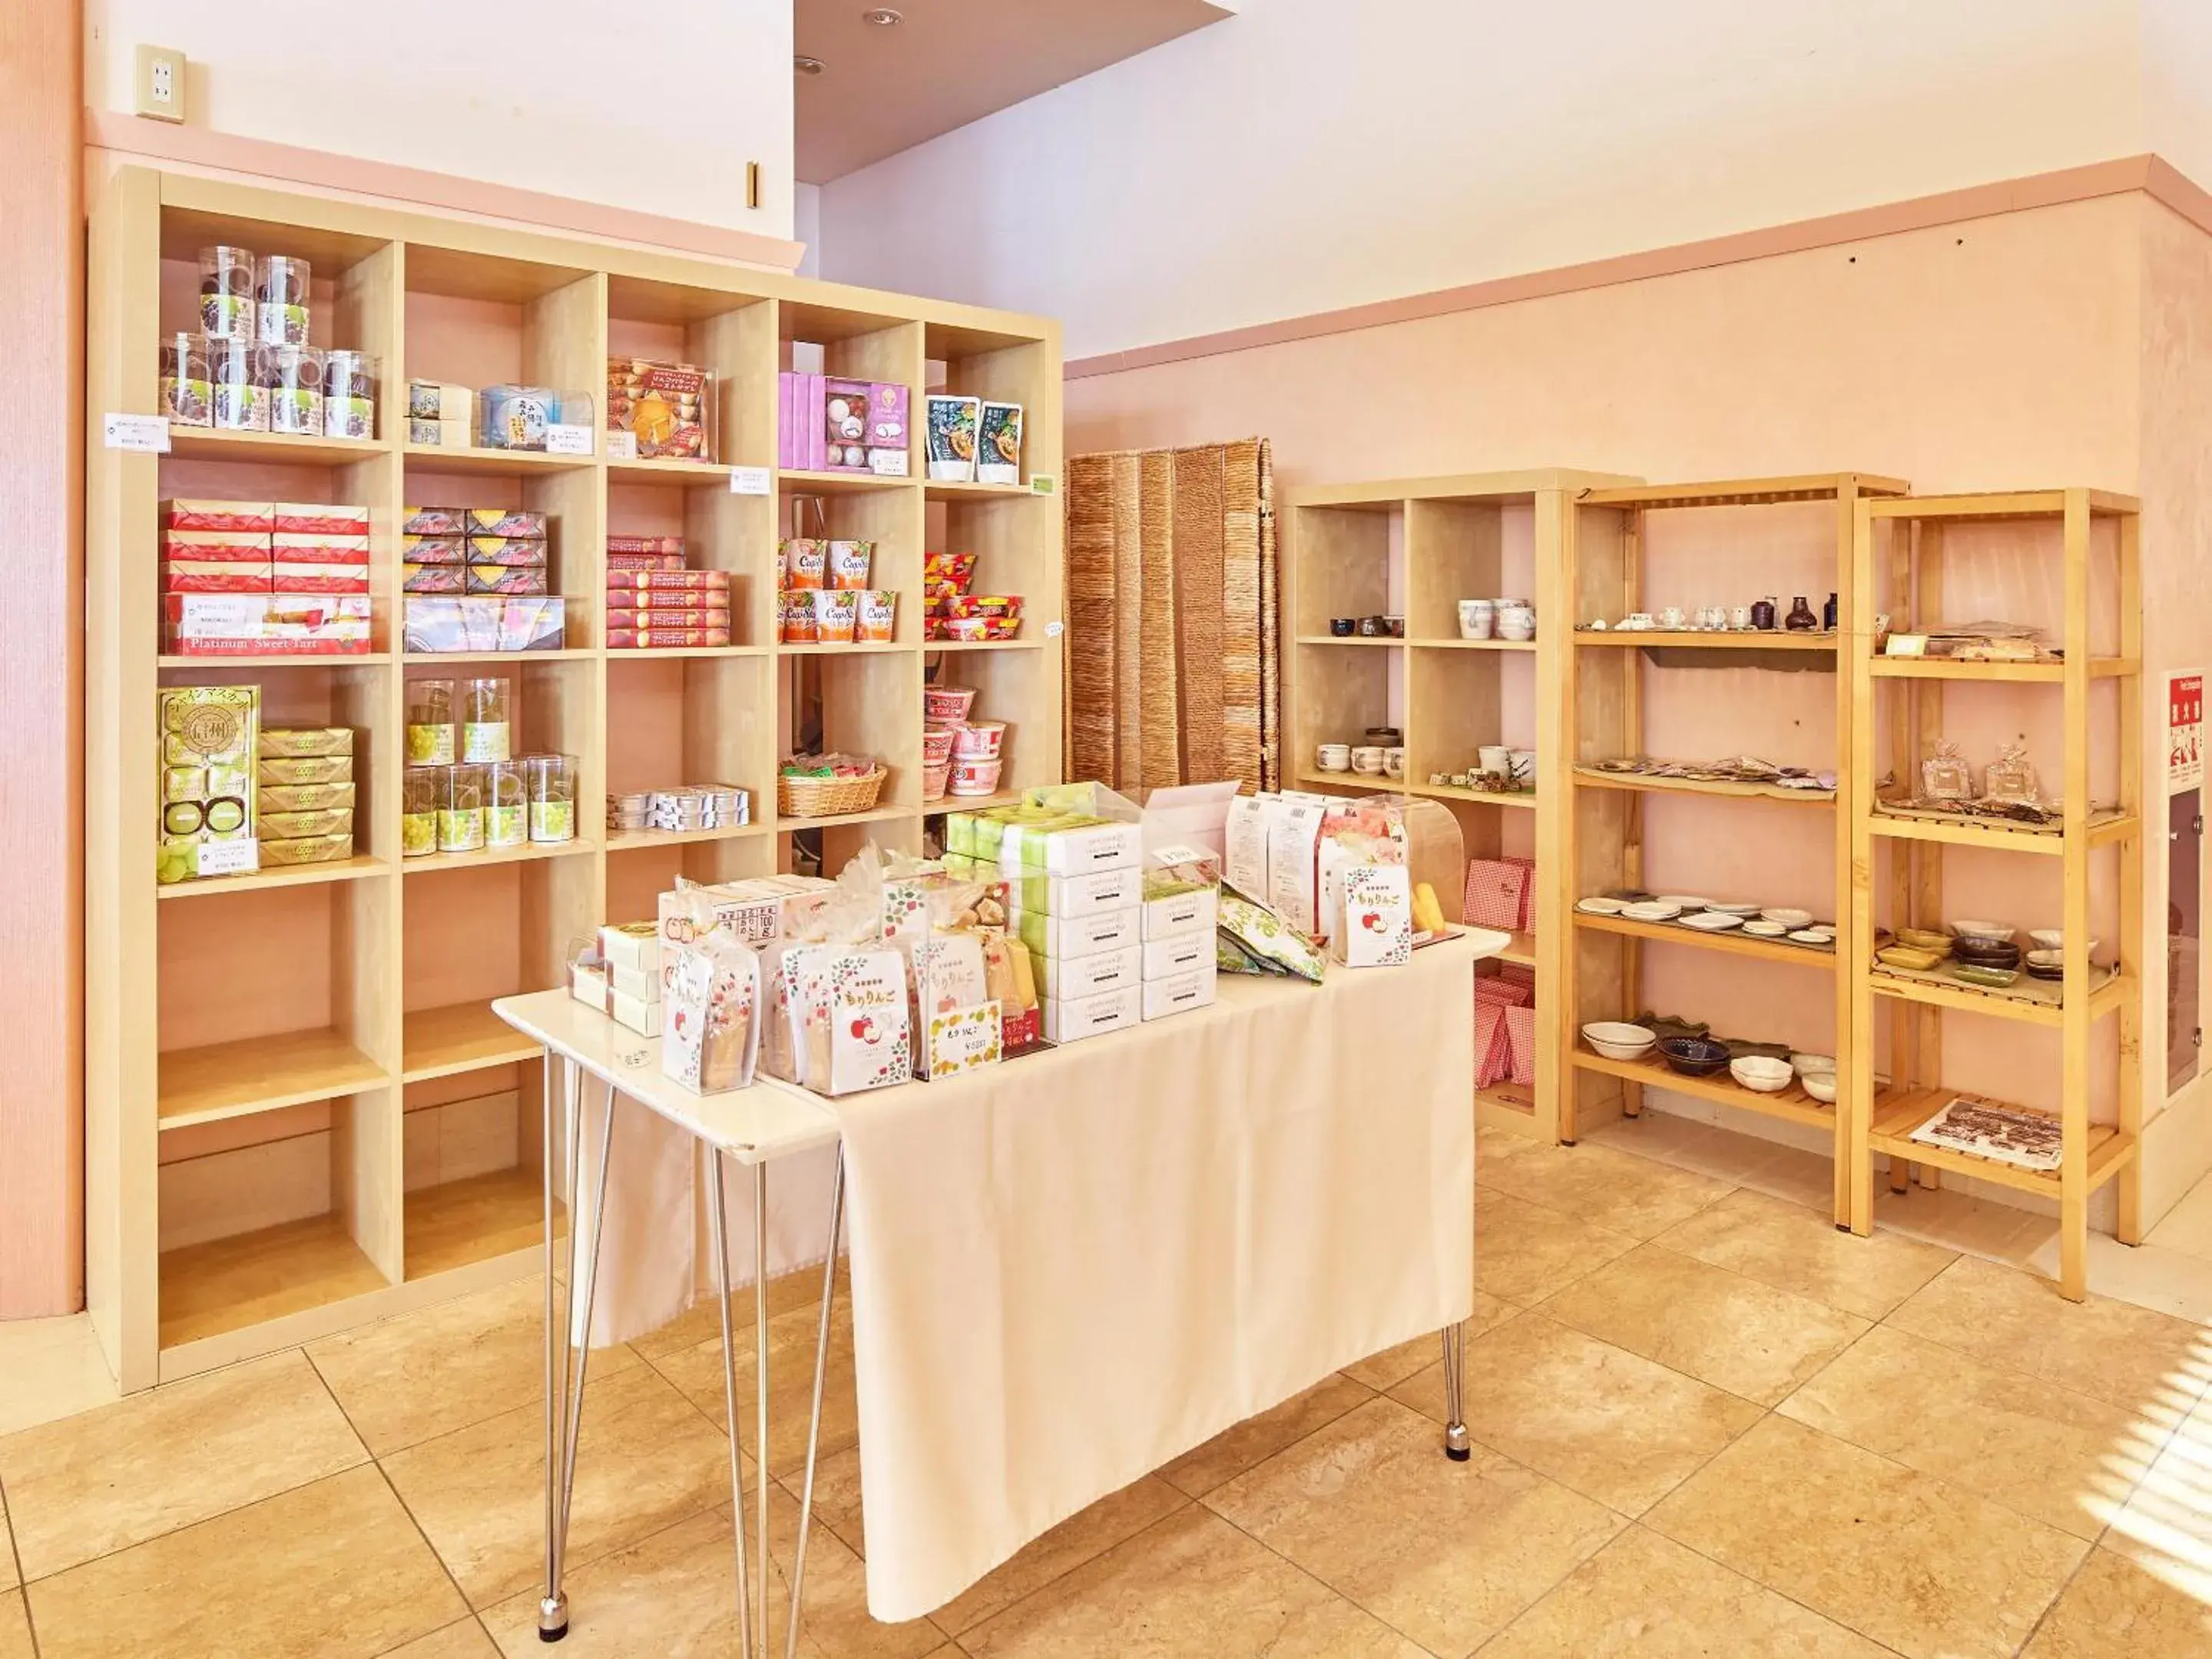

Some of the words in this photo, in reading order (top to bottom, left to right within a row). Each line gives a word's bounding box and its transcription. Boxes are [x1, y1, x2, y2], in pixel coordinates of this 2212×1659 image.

[190, 637, 248, 649] Platinum
[254, 638, 290, 649] Sweet
[293, 638, 317, 649] Tart
